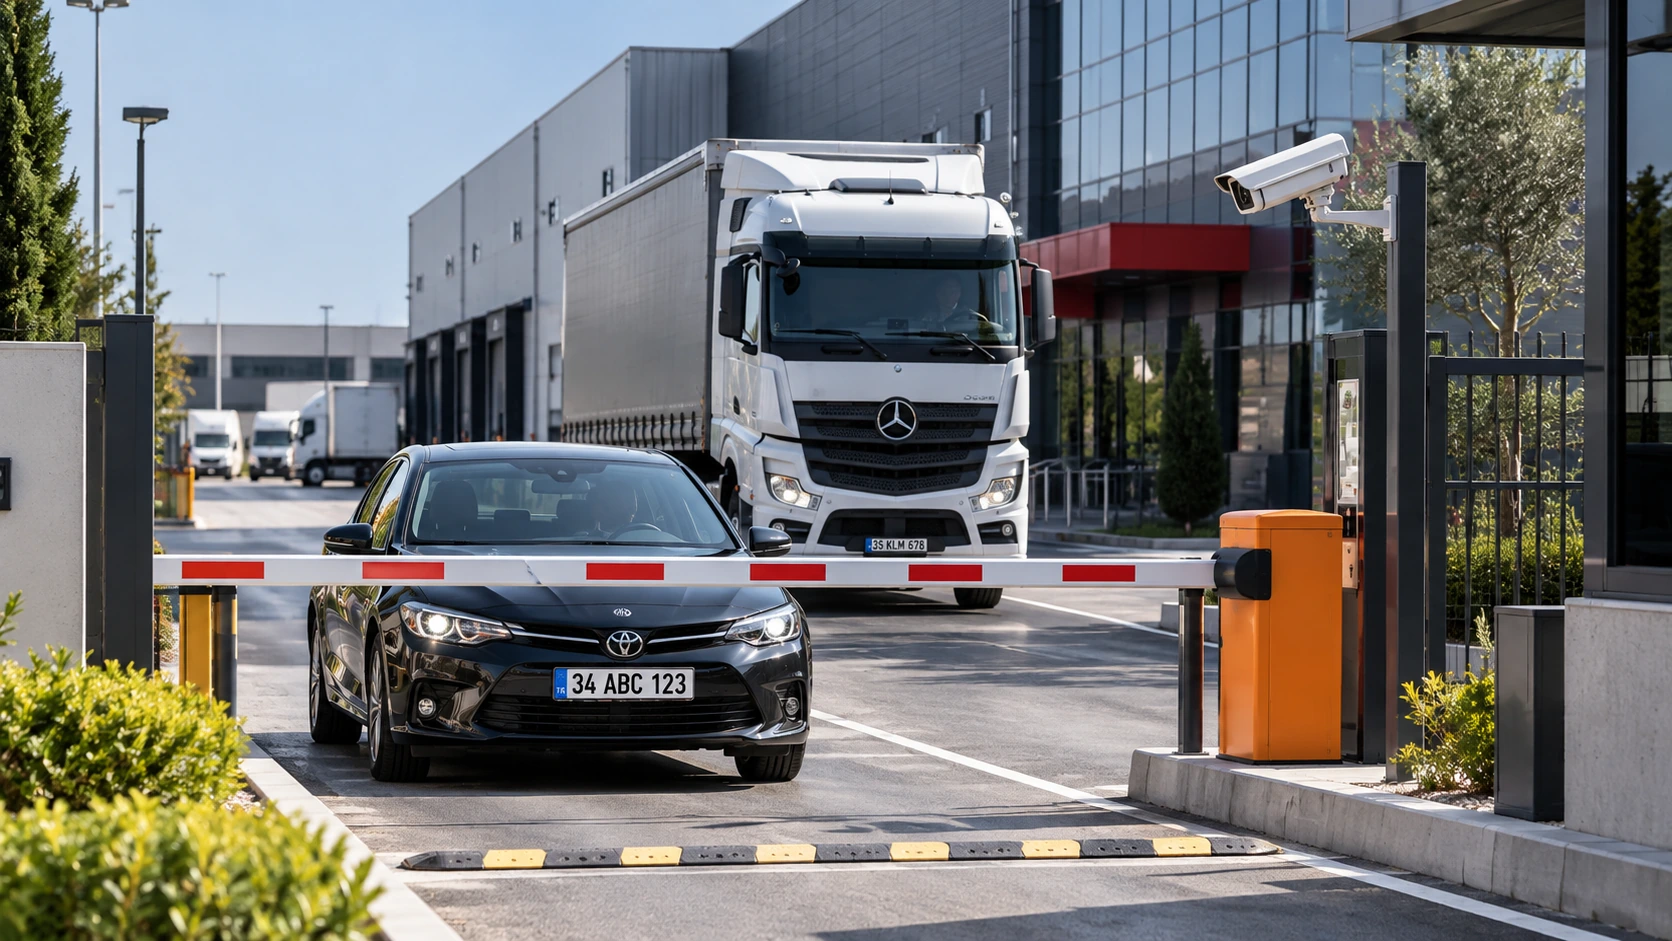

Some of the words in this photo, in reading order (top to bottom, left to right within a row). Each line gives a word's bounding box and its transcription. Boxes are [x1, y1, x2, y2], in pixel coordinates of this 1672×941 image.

[886, 540, 905, 550] KLM
[908, 540, 925, 550] 678
[572, 673, 596, 694] 34
[604, 673, 643, 694] ABC
[652, 673, 686, 694] 123
